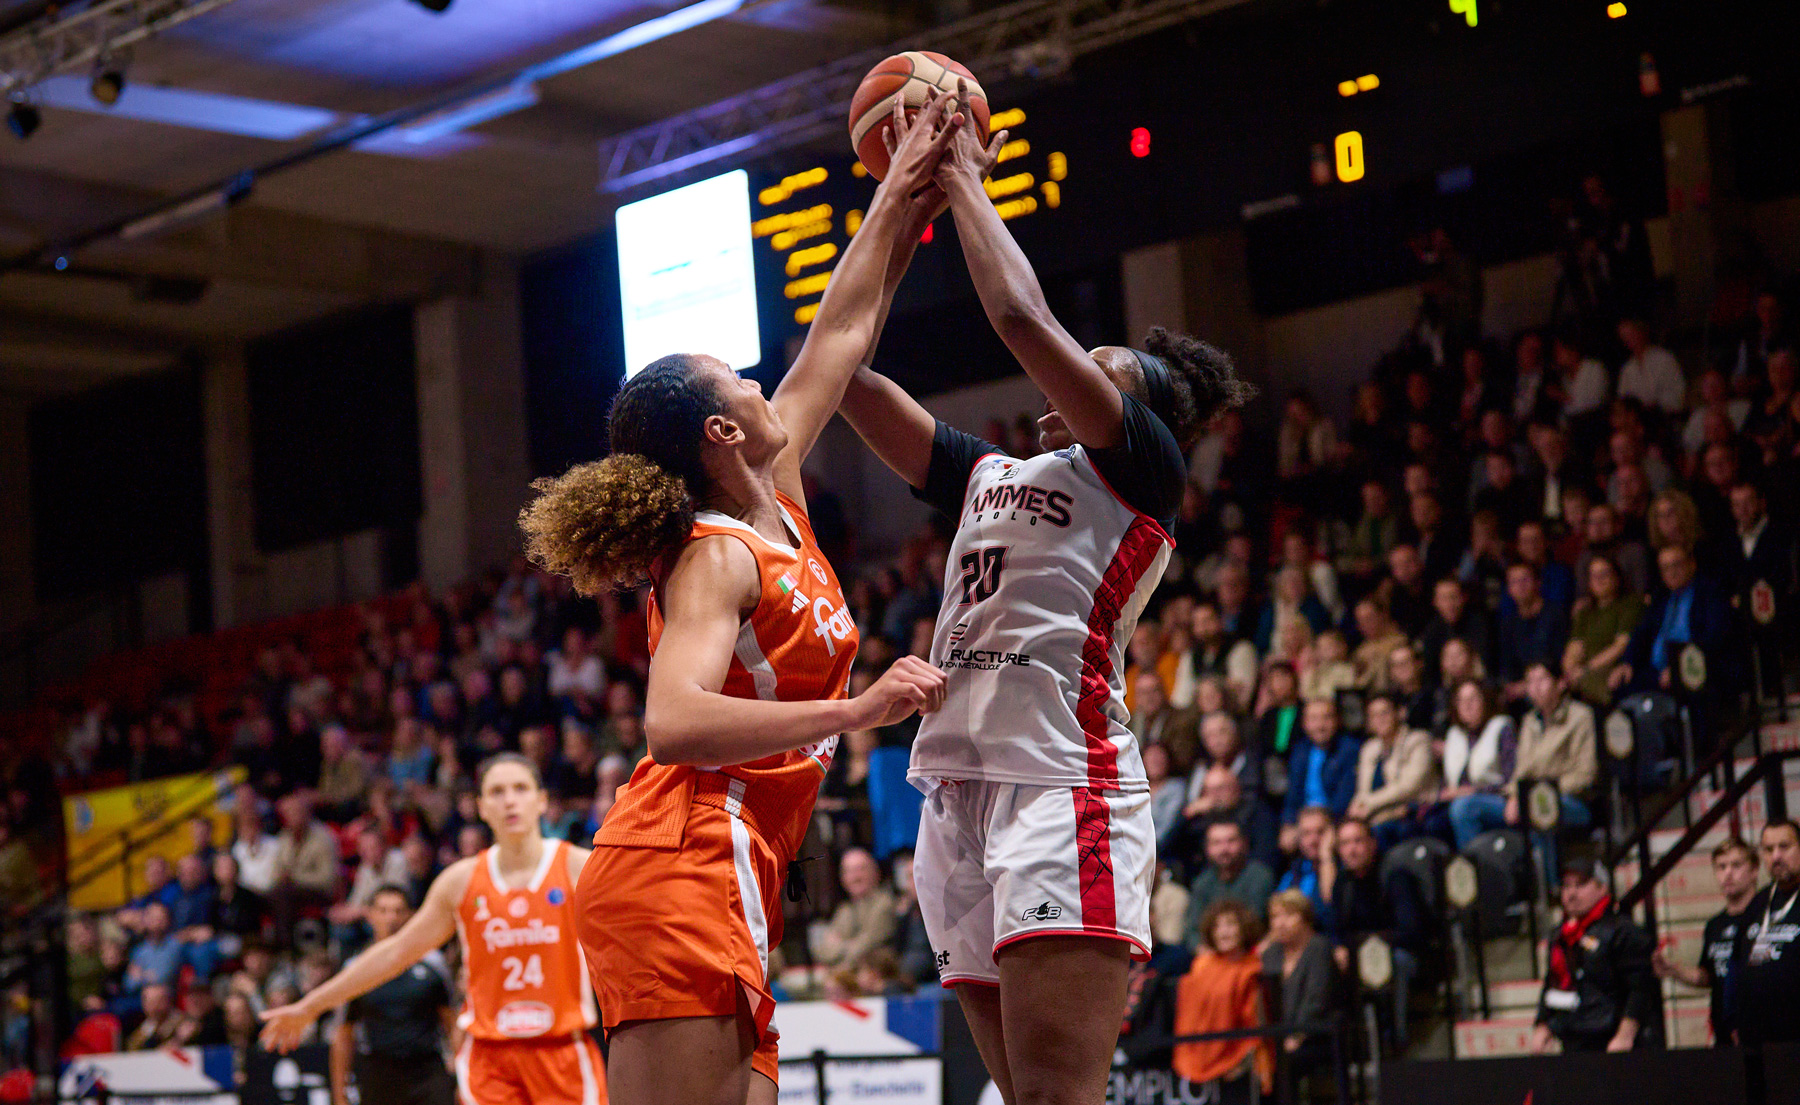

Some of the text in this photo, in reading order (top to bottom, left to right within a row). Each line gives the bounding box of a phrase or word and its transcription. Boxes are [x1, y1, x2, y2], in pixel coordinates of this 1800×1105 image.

[1335, 131, 1364, 183] 0
[958, 546, 1009, 607] 20
[501, 953, 545, 991] 24
